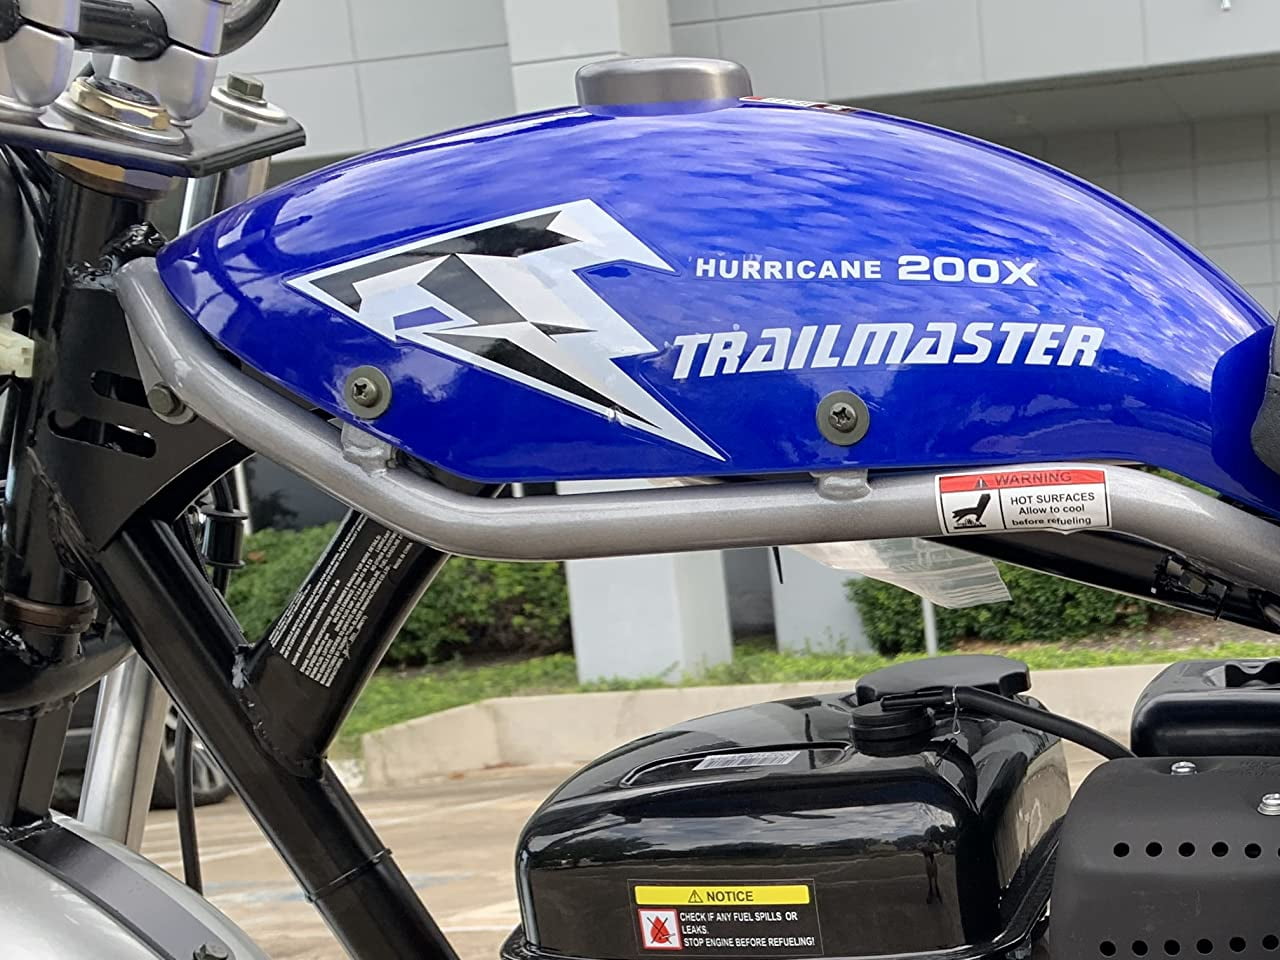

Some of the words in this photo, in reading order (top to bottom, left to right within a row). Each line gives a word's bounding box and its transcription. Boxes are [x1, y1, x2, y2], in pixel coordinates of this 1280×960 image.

[695, 258, 882, 281] HURRICANE
[897, 255, 1039, 287] 200X
[672, 322, 1106, 380] TRAILMASTER
[994, 472, 1072, 486] WARNING
[1010, 495, 1033, 505] HOT
[1036, 492, 1095, 504] SURFACES
[1019, 506, 1047, 515] Allow
[1050, 505, 1060, 514] to
[1063, 504, 1085, 513] cool
[1012, 518, 1045, 526] before
[1047, 516, 1092, 526] refueling
[706, 891, 754, 902] NOTICE
[680, 912, 706, 921] CHECK
[707, 912, 715, 921] IF
[716, 912, 732, 921] ANY
[733, 912, 754, 921] FUEL
[754, 911, 782, 921] SPILLS
[785, 911, 798, 921] OR
[681, 925, 709, 935] LEAKS.
[684, 938, 704, 947] STOP
[705, 938, 734, 947] ENGINE
[735, 937, 767, 947] BEFORE
[768, 936, 815, 947] REFUELING!
